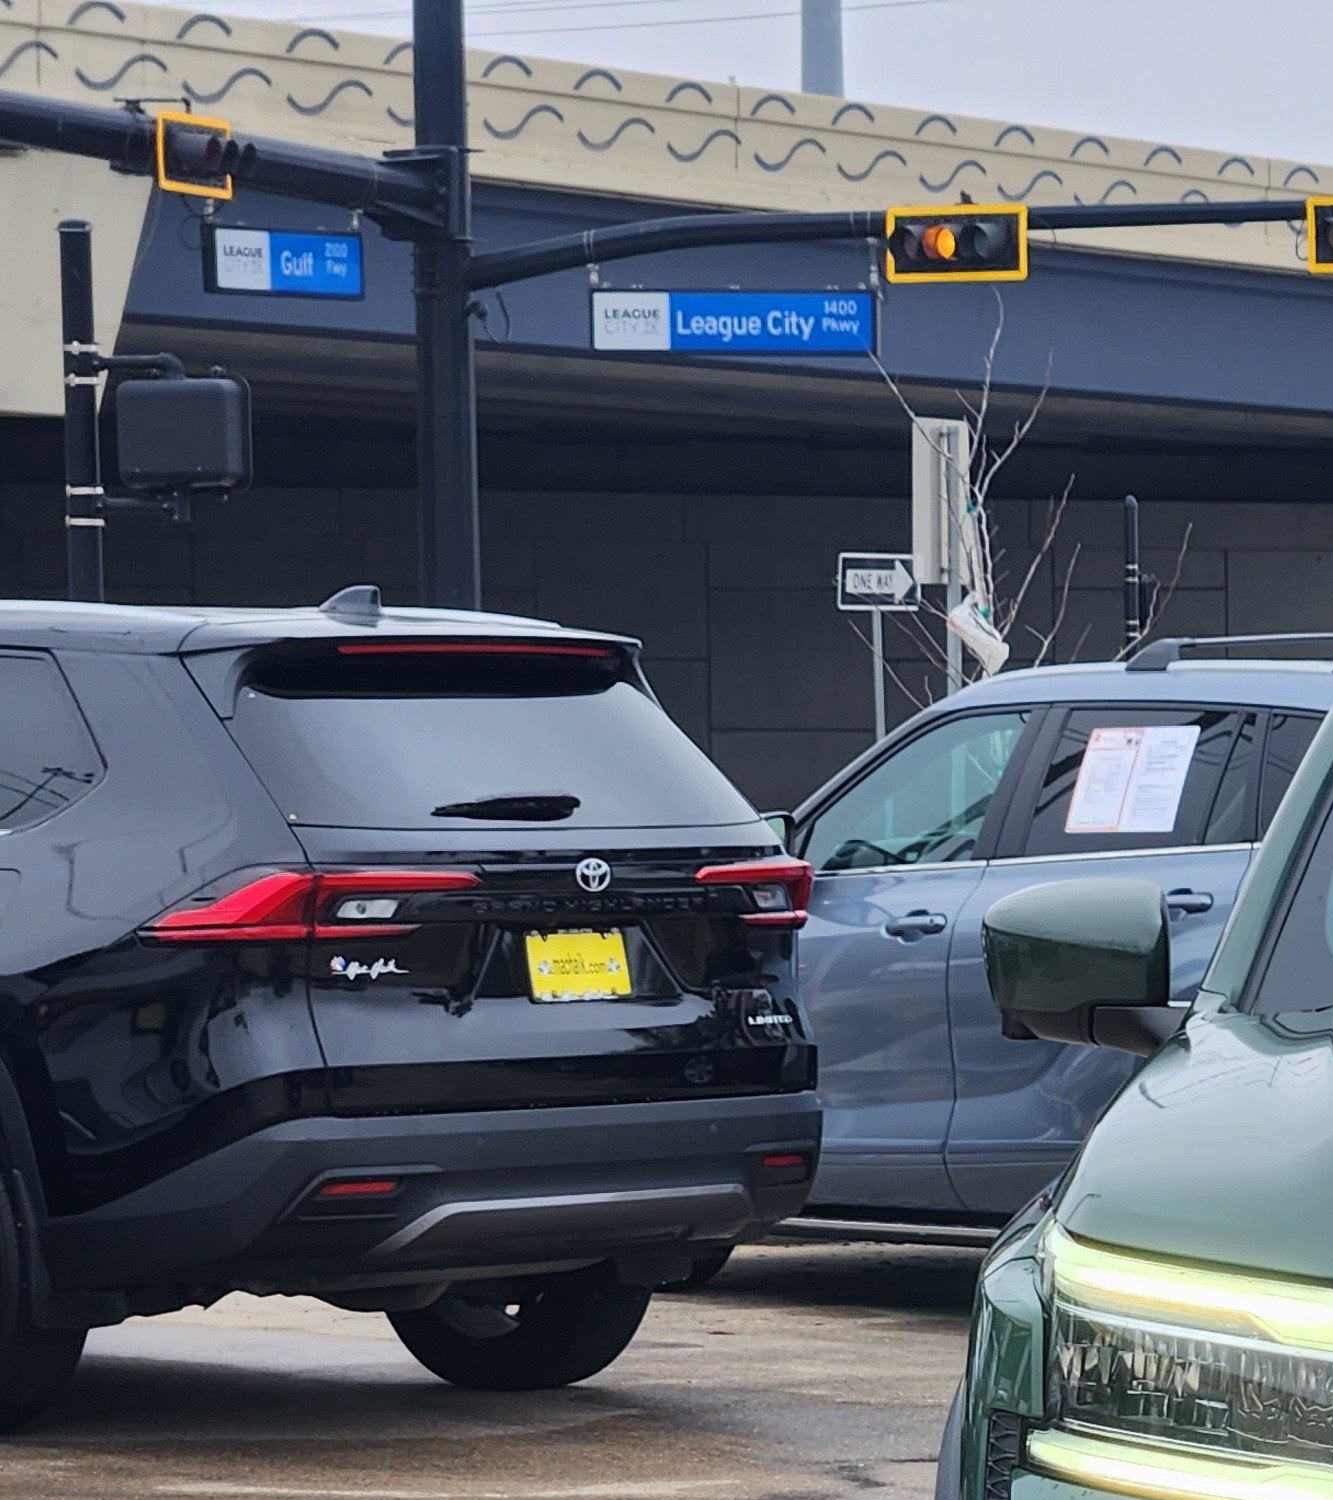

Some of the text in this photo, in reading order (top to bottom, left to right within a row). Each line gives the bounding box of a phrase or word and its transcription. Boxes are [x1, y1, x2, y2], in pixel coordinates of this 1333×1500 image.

[223, 244, 263, 258] LEAGUE
[280, 250, 314, 277] Gulf
[326, 260, 348, 278] Fwy
[604, 308, 661, 320] LEAGUE
[823, 300, 858, 315] 1400
[676, 310, 815, 342] League City
[822, 318, 860, 335] Pkwy
[853, 573, 894, 591] ONE WAY
